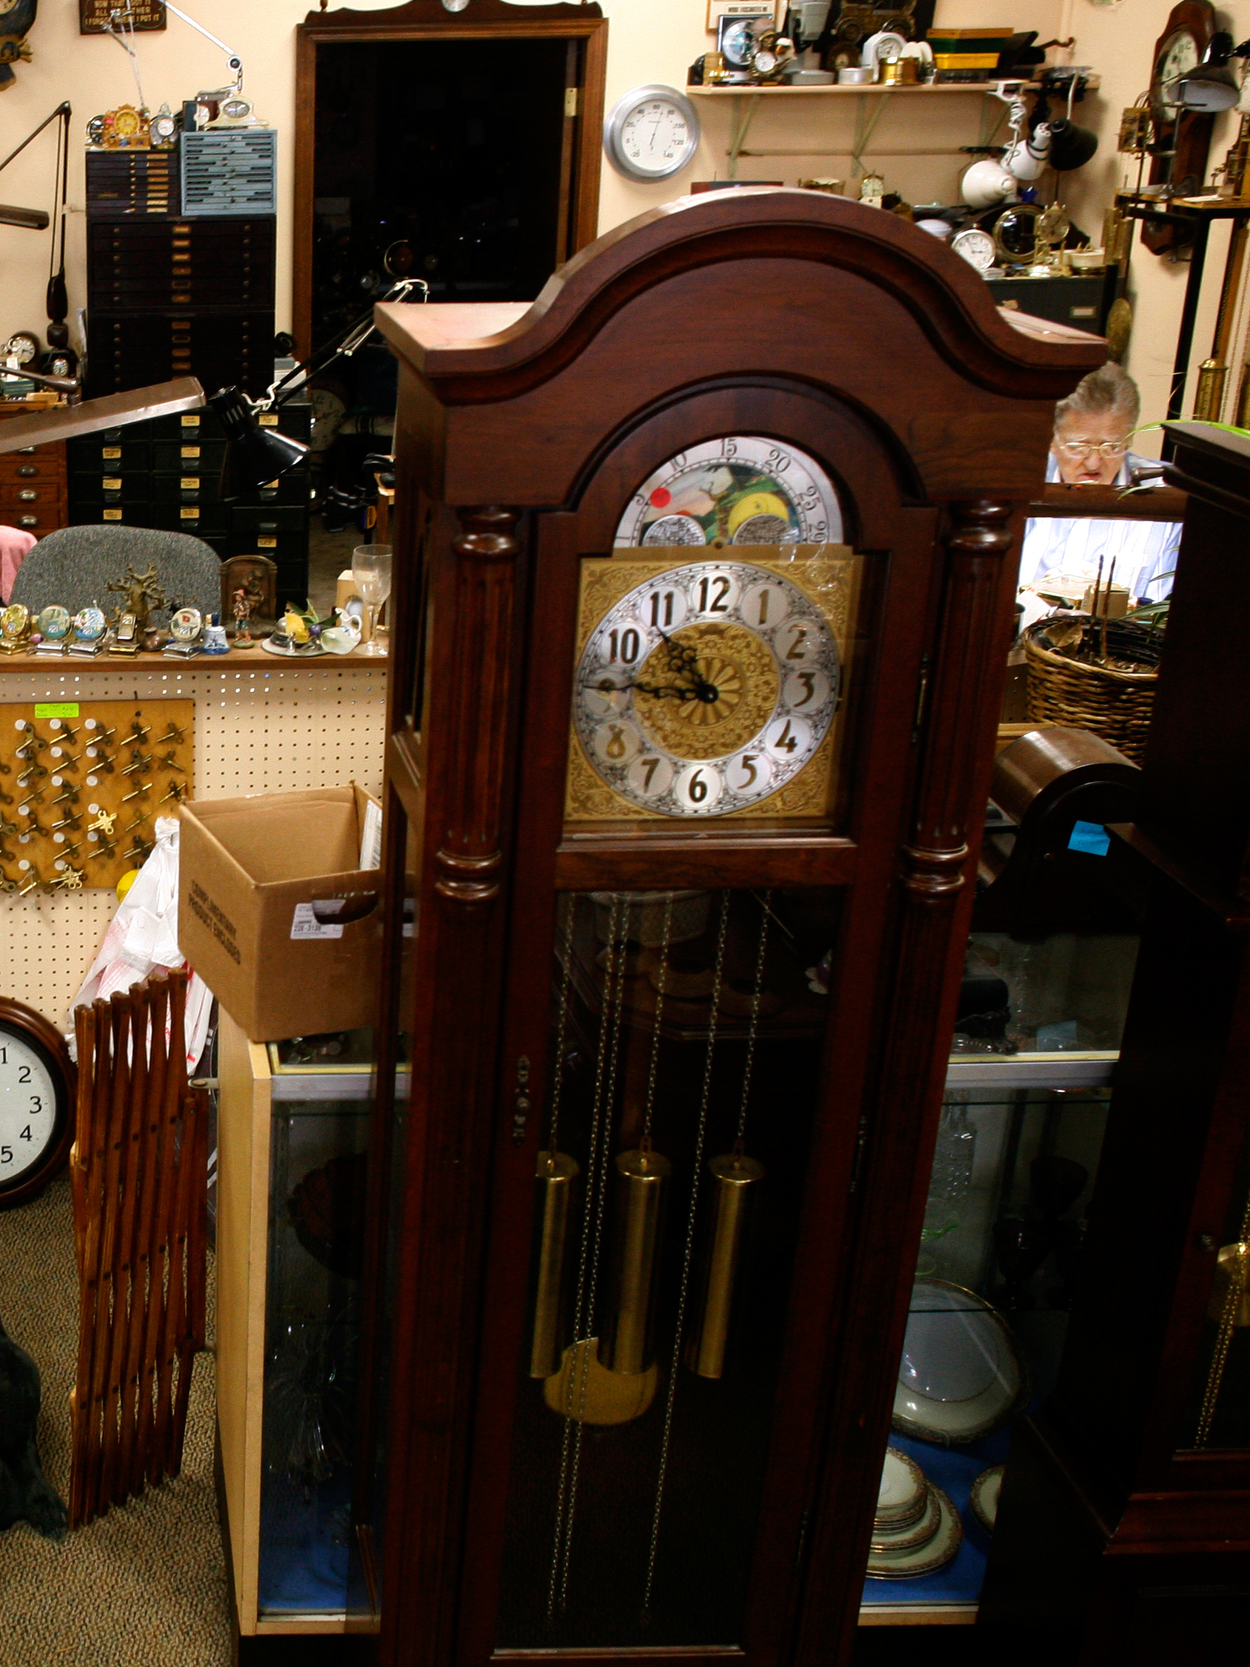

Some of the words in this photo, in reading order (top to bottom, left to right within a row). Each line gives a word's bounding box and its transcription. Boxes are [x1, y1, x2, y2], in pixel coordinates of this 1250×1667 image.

[720, 438, 737, 456] 15
[764, 449, 791, 473] 20
[798, 485, 819, 511] 25
[650, 591, 675, 628] 11
[699, 576, 731, 613] 12
[758, 589, 770, 626] 1
[609, 628, 640, 665] 10
[786, 624, 808, 660] 2
[793, 672, 817, 708] 3
[606, 724, 626, 759] 8
[774, 719, 798, 753] 4
[641, 758, 660, 794] 7
[688, 769, 708, 803] 6
[737, 755, 760, 790] 5
[0, 1047, 8, 1064] 1
[18, 1066, 32, 1083] 2
[29, 1096, 42, 1114] 3
[19, 1125, 33, 1142] 4
[0, 1146, 13, 1164] 5
